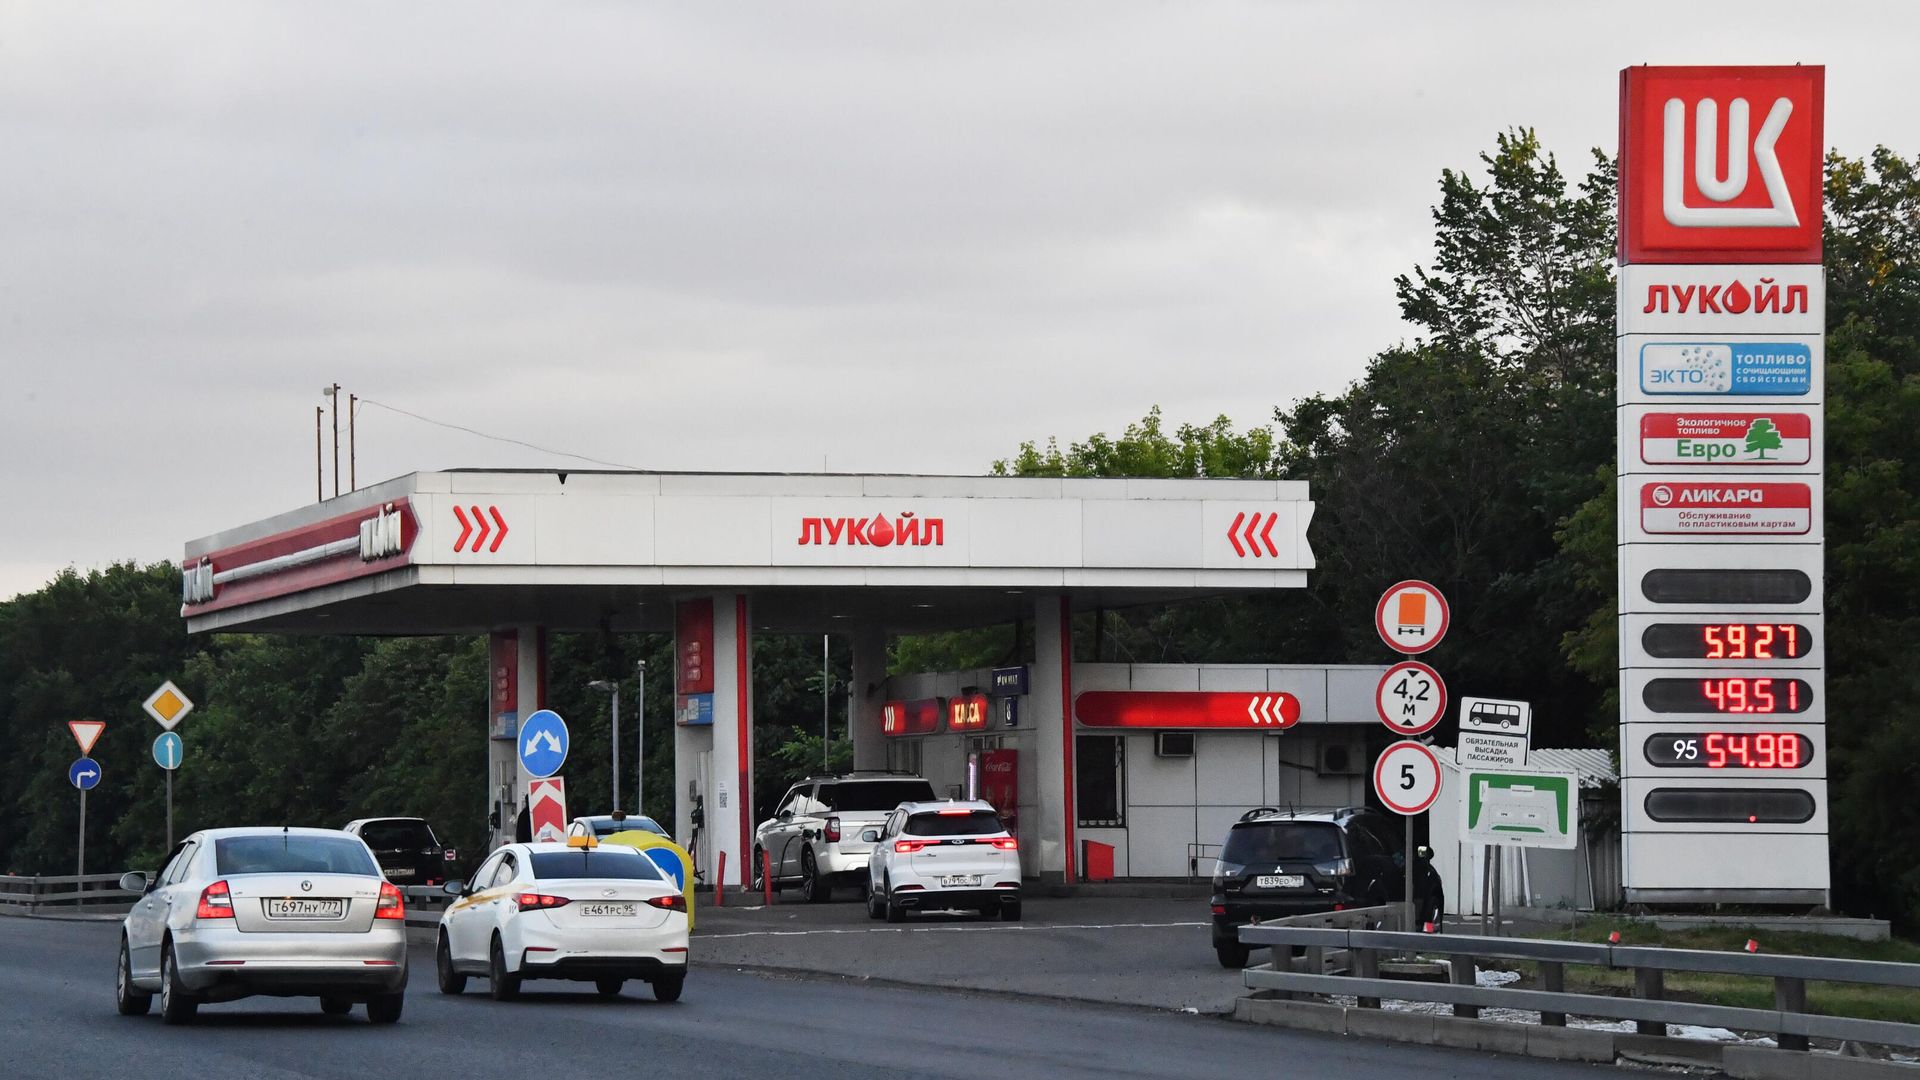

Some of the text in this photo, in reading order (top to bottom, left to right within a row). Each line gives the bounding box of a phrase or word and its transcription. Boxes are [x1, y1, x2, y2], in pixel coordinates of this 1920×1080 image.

[1643, 277, 1808, 314] ЛУКОЙЛ
[1736, 354, 1806, 365] ТОПЛИВО
[1651, 369, 1703, 384] ЭКТО
[1677, 418, 1747, 428] Экологичное
[1677, 439, 1737, 461] Евро
[1679, 511, 1752, 521] Обслуживание
[798, 511, 943, 547] ЛУКОЙЛ
[1761, 521, 1796, 529] картам
[1393, 678, 1430, 702] 4,2
[1704, 679, 1797, 712] 49.51
[1465, 737, 1519, 748] ОБЯЗАТЕЛЬНАЯ
[1474, 746, 1508, 755] ВЫСАДКА
[1673, 734, 1798, 767] 95 54.98
[1467, 753, 1514, 764] ПАССАЖИРОВ
[1400, 764, 1415, 790] 5
[274, 901, 338, 912] Т697НУ 777
[584, 904, 634, 915] Е461РС 95
